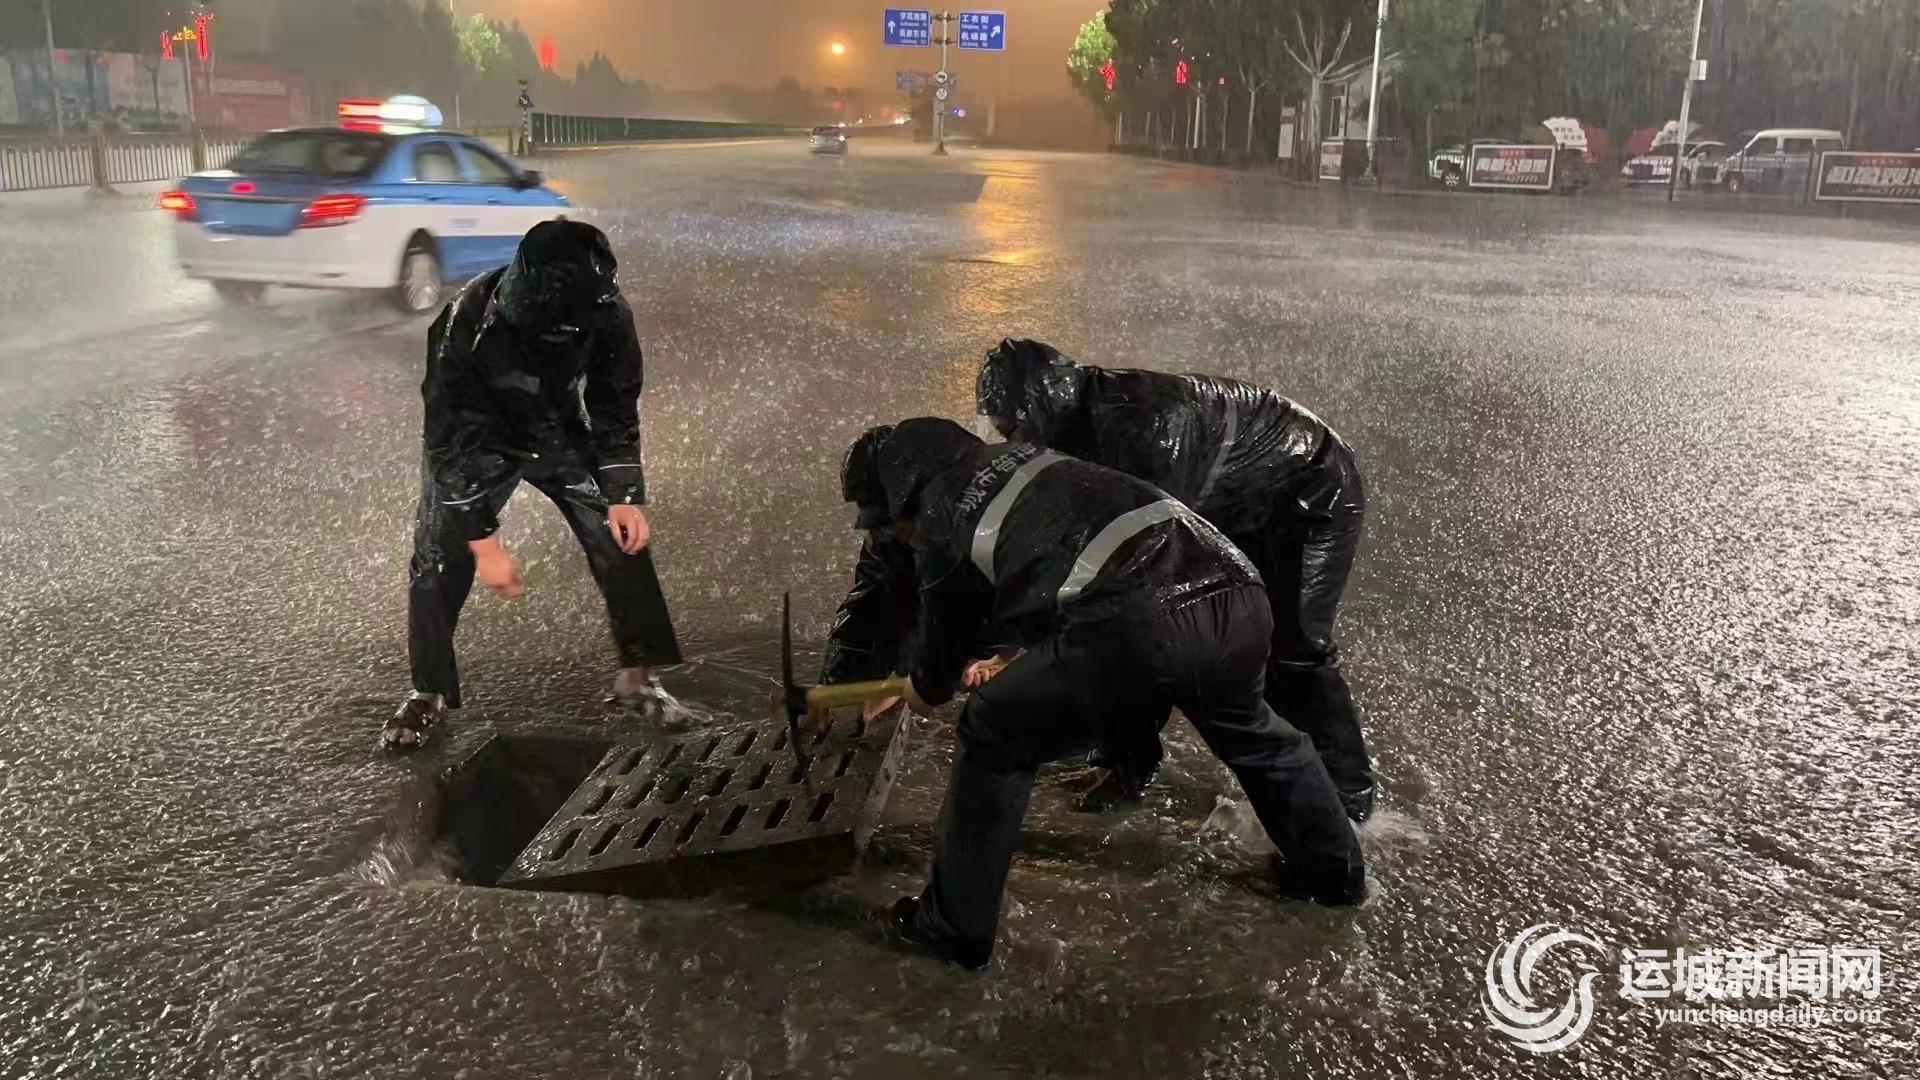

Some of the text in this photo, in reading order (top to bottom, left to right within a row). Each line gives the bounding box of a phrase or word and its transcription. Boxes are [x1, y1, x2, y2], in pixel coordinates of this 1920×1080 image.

[961, 14, 989, 24] 工农街
[961, 31, 989, 41] 机场路
